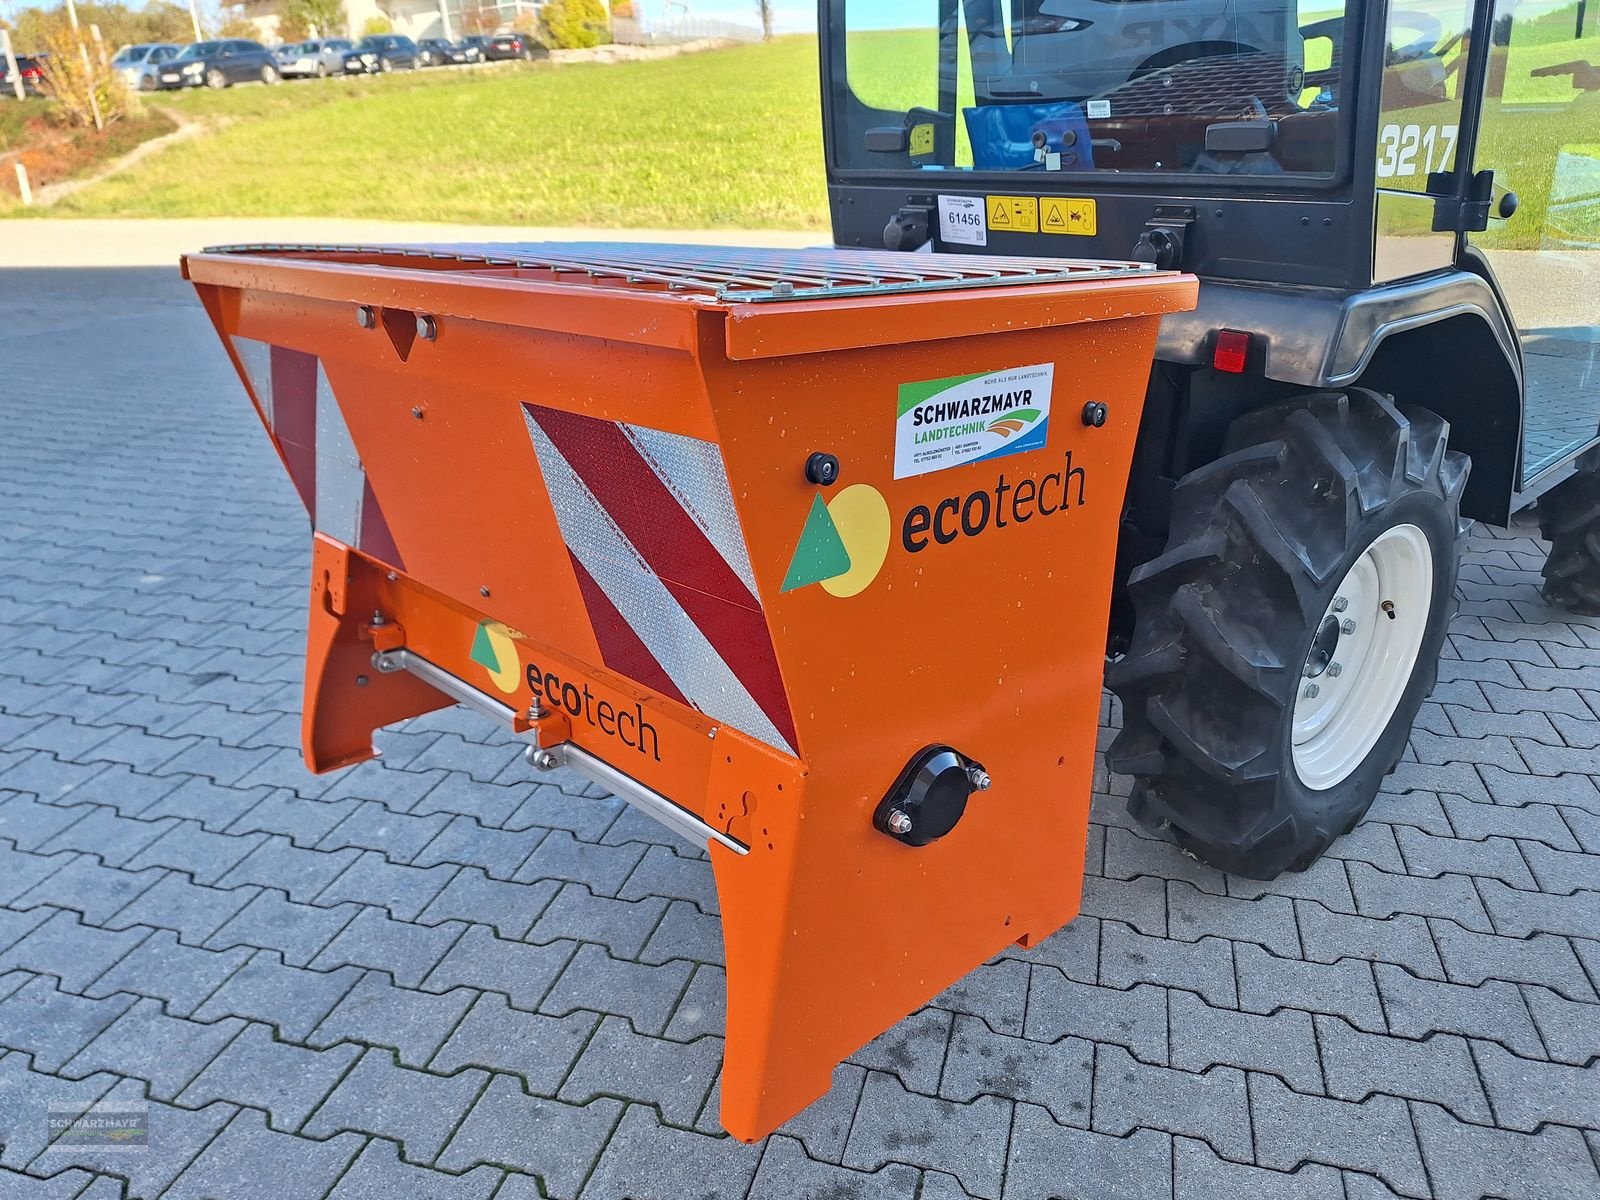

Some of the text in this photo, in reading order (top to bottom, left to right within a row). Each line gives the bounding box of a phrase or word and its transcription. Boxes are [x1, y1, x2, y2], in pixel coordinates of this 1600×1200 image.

[1377, 124, 1458, 177] 3217
[948, 211, 981, 226] 61456
[912, 389, 1032, 426] SCHWARZMAYR
[914, 420, 986, 445] LANDTECHNIK
[902, 450, 1086, 554] ecotech
[526, 662, 661, 763] ecotech
